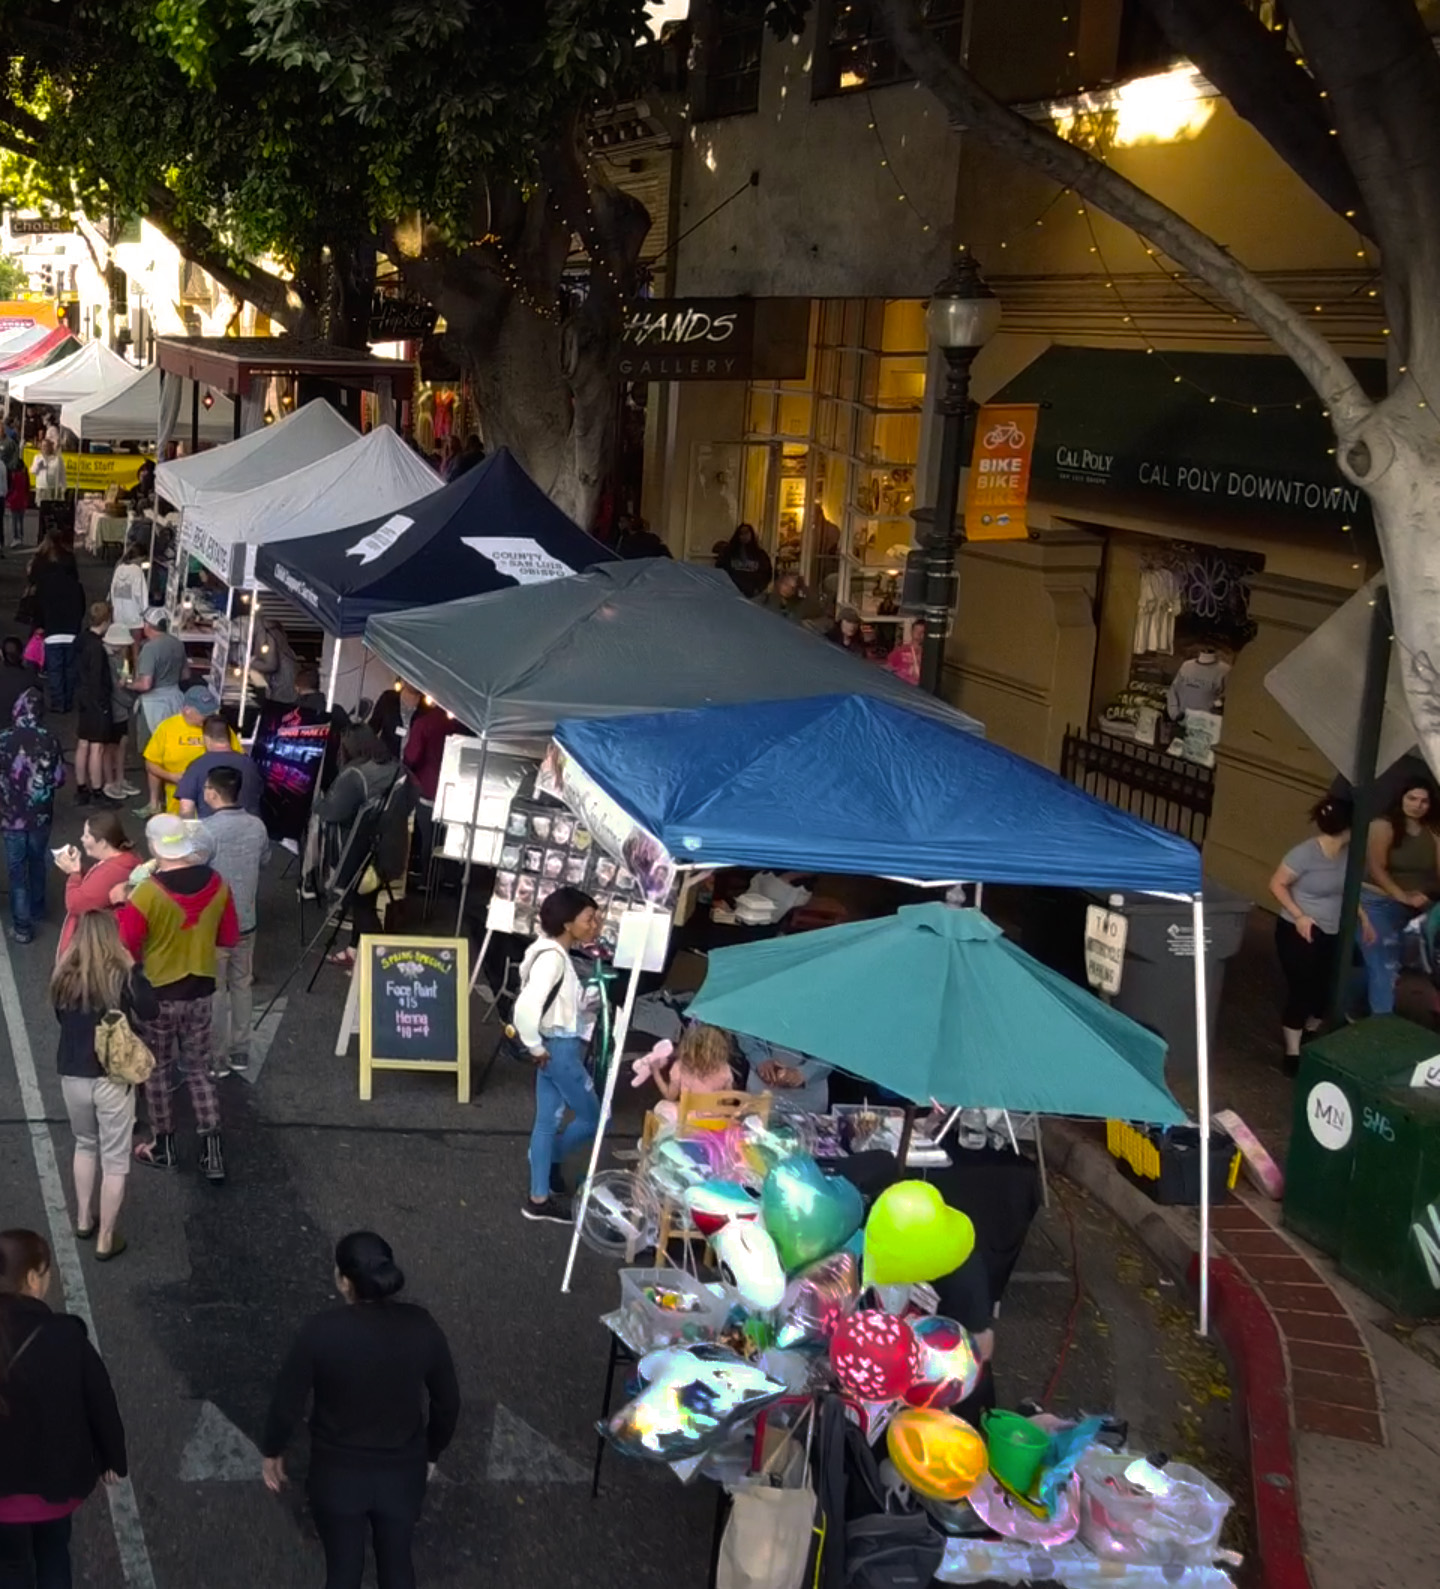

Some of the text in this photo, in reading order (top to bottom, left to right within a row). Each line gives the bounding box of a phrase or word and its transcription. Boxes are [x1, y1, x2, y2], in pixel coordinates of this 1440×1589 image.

[622, 307, 739, 347] HANDS
[620, 359, 736, 376] GALLERY
[979, 458, 1023, 473] BIKE
[1056, 446, 1114, 472] CAL POLY
[977, 474, 1022, 489] BIKE
[1138, 462, 1360, 514] CAL POLY DOWNTOWN
[492, 551, 542, 561] COUNTY
[386, 979, 438, 999] Face Paint
